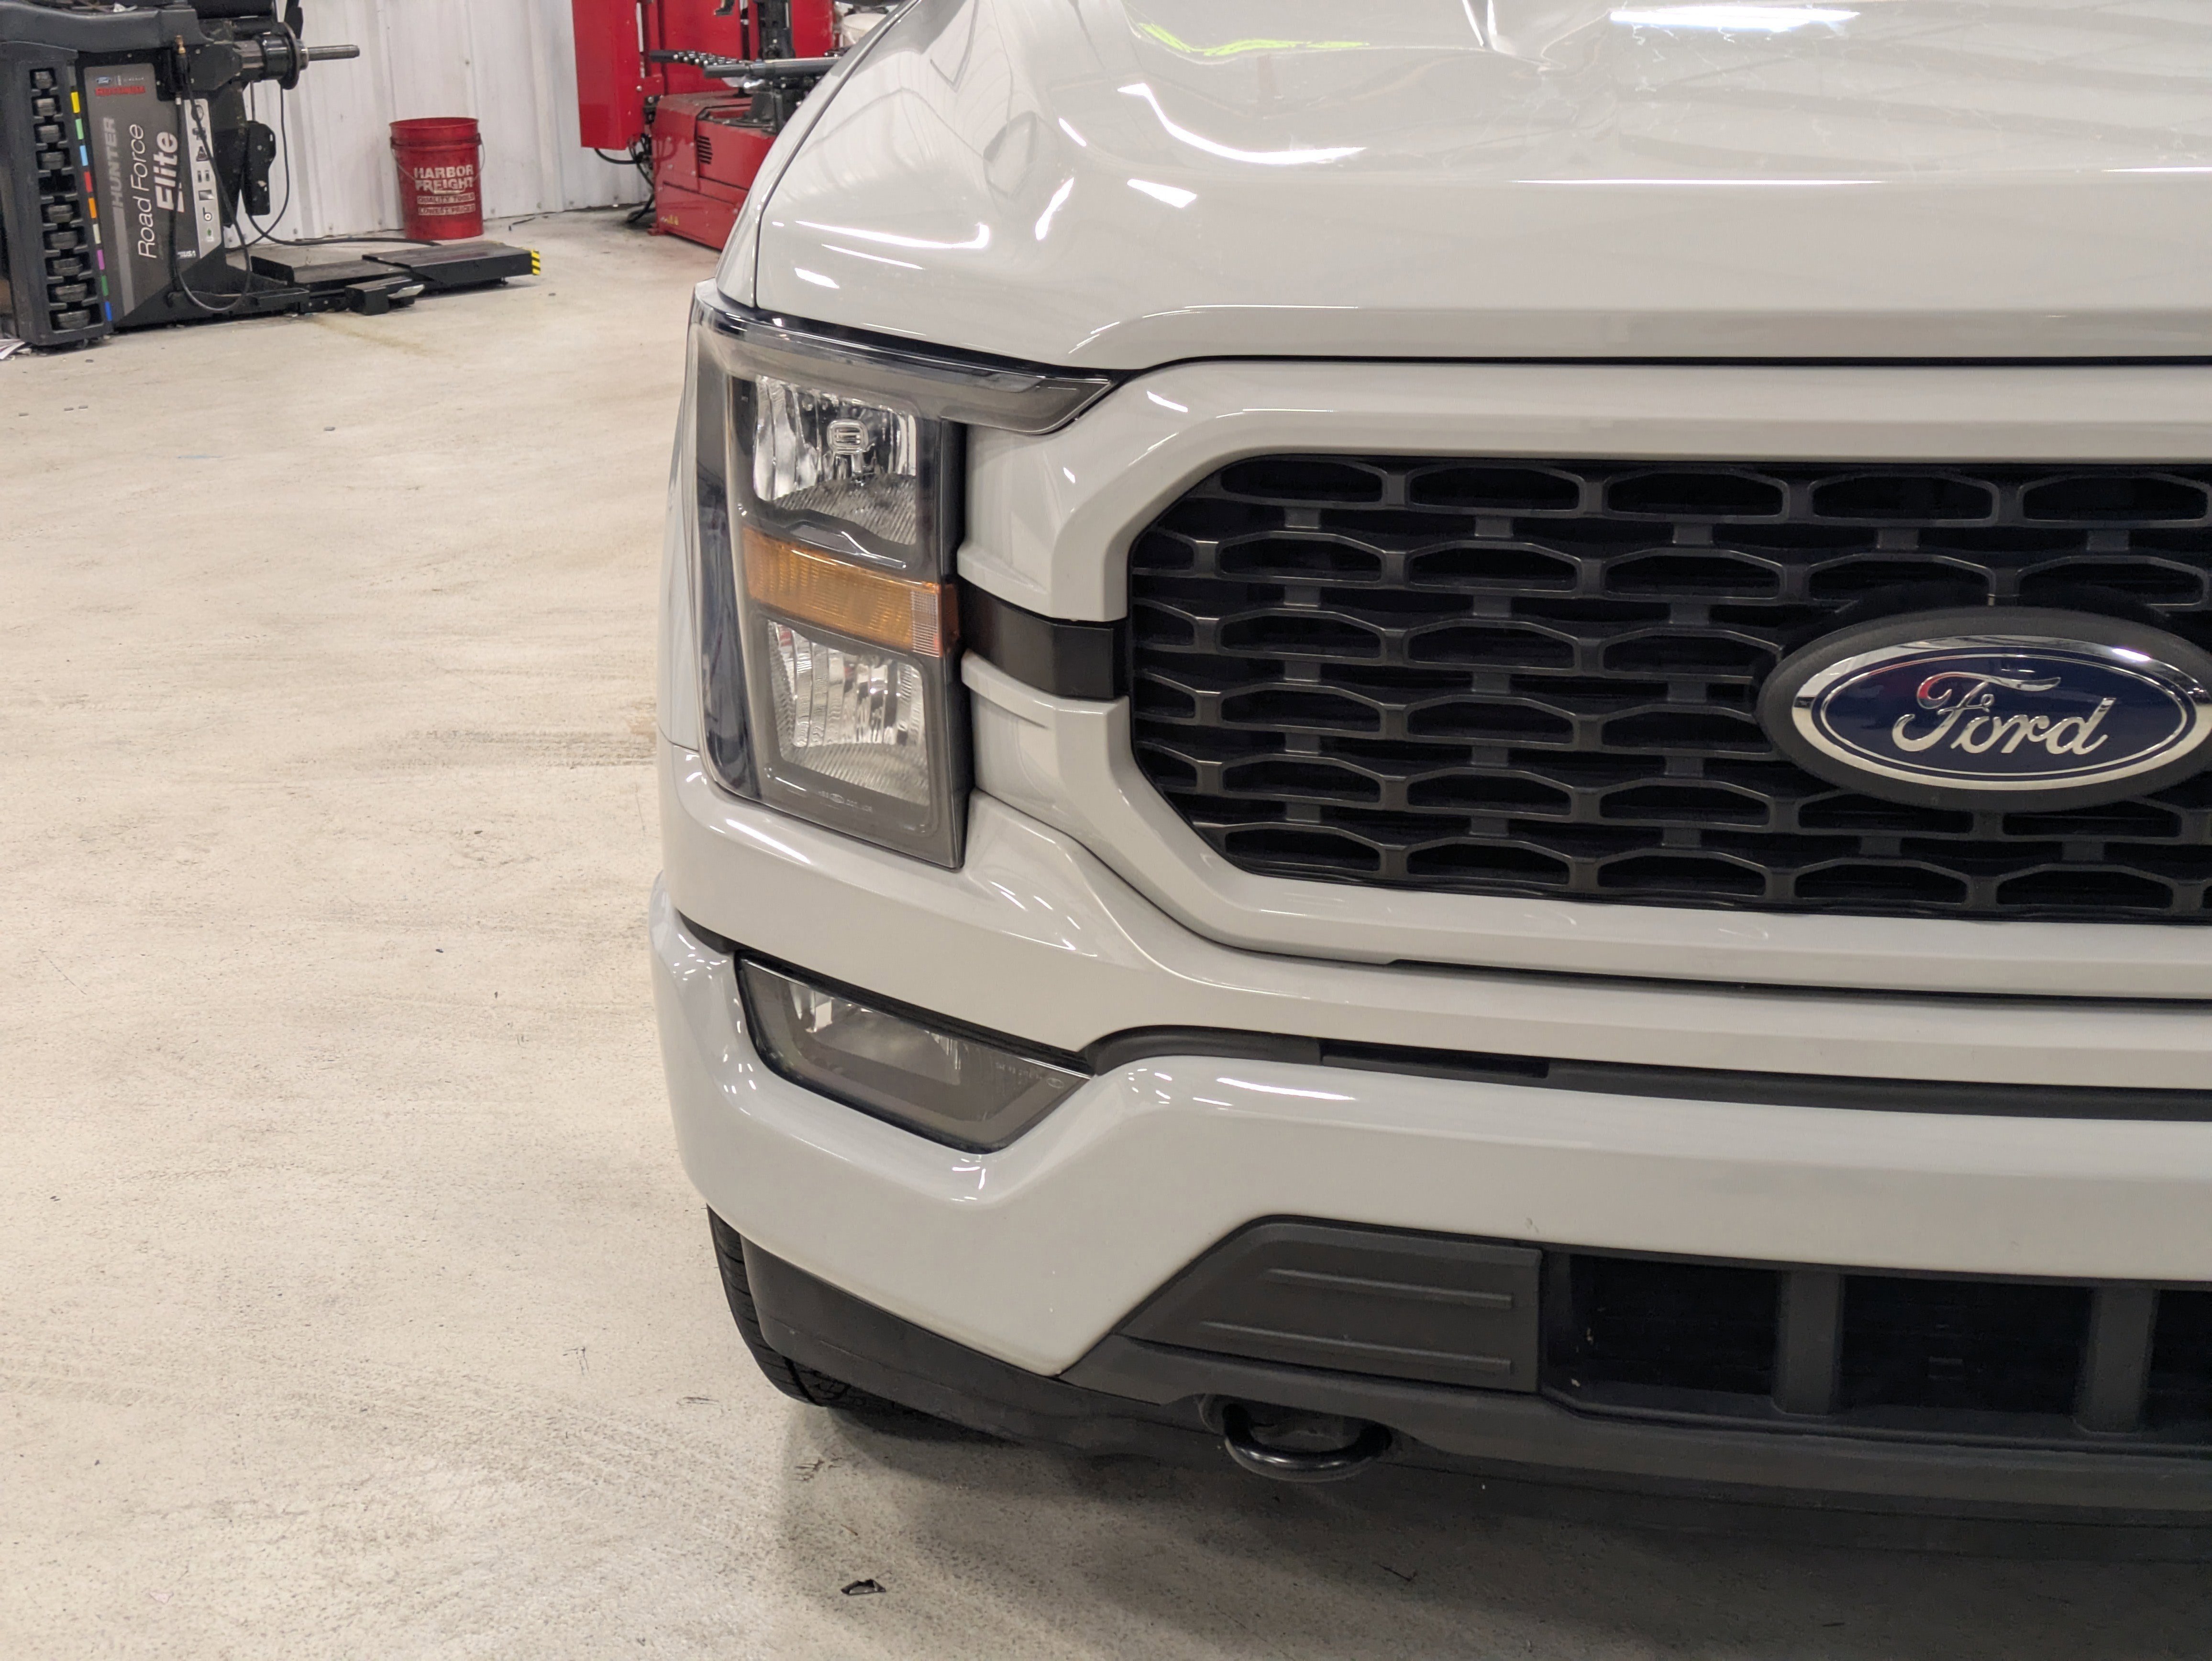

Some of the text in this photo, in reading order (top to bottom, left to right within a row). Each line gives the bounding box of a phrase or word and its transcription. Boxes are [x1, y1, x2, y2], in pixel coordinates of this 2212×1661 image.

[103, 118, 123, 208] HUNTER
[129, 124, 157, 258] Road Force
[153, 132, 178, 210] Elite
[414, 164, 474, 179] HARBOR
[414, 177, 473, 191] FREIGHT
[1891, 671, 2116, 754] Ford
